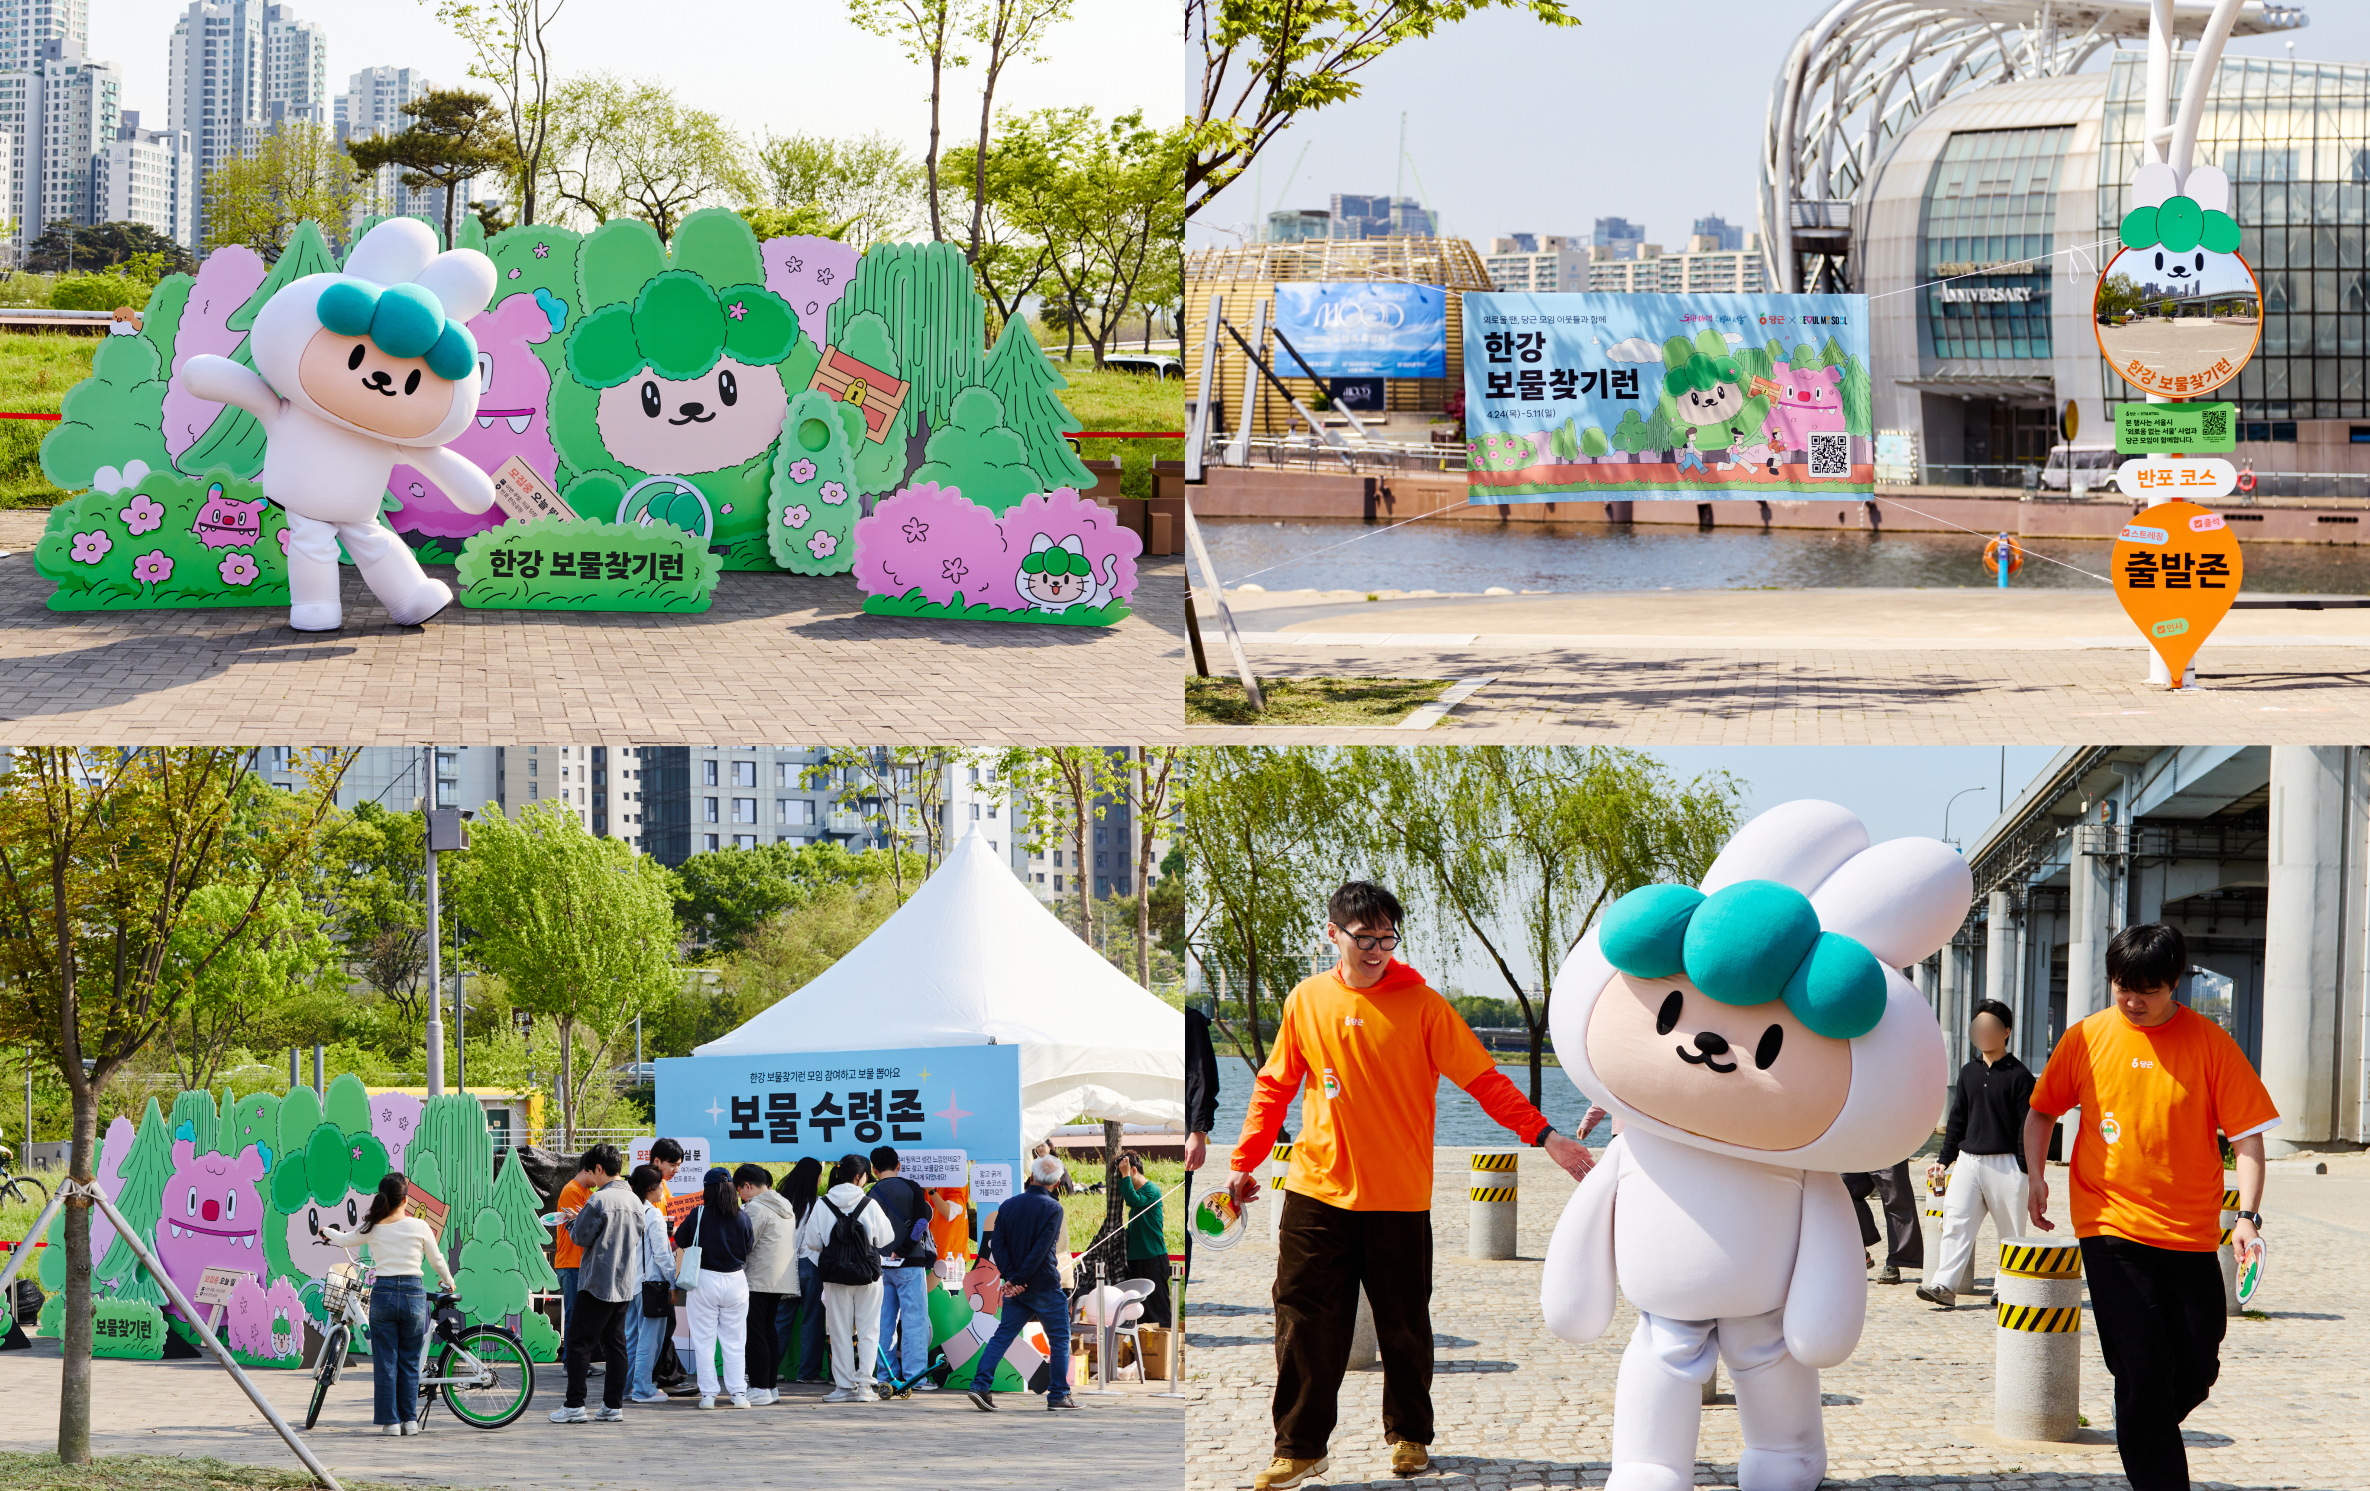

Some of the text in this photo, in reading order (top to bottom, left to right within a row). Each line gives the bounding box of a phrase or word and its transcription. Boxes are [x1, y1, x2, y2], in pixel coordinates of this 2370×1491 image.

[1941, 282, 2032, 303] ANNIVERSARY
[1313, 301, 1405, 329] MOOD
[1483, 315, 1507, 325] 외로울
[1521, 315, 1537, 325] 당근
[1539, 315, 1555, 325] 모임
[1557, 315, 1589, 325] 이웃들과
[1590, 315, 1607, 324] 함께
[1769, 315, 1785, 325] 당근
[1484, 331, 1546, 363] 한강
[1486, 368, 1639, 401] 보물찾기런
[2127, 357, 2233, 392] 한강 보물찾기런
[2178, 427, 2197, 435] 사업과
[2137, 468, 2217, 488] 반포 코스
[507, 467, 535, 494] 모집중
[530, 491, 549, 511] 오늘
[2203, 517, 2221, 528] 출석
[2130, 529, 2164, 542] 스트레칭
[489, 549, 684, 581] 한강 보물찾기런
[2125, 551, 2230, 589] 출발존
[2166, 621, 2184, 633] 인사
[750, 1067, 901, 1083] 한강 보물찾기런 모임 참여하고 보물 뽑아요
[728, 1088, 925, 1144] 보물 수령존
[693, 1150, 701, 1161] 분
[219, 1277, 229, 1286] 오늘
[96, 1319, 151, 1339] 보물찾기런
